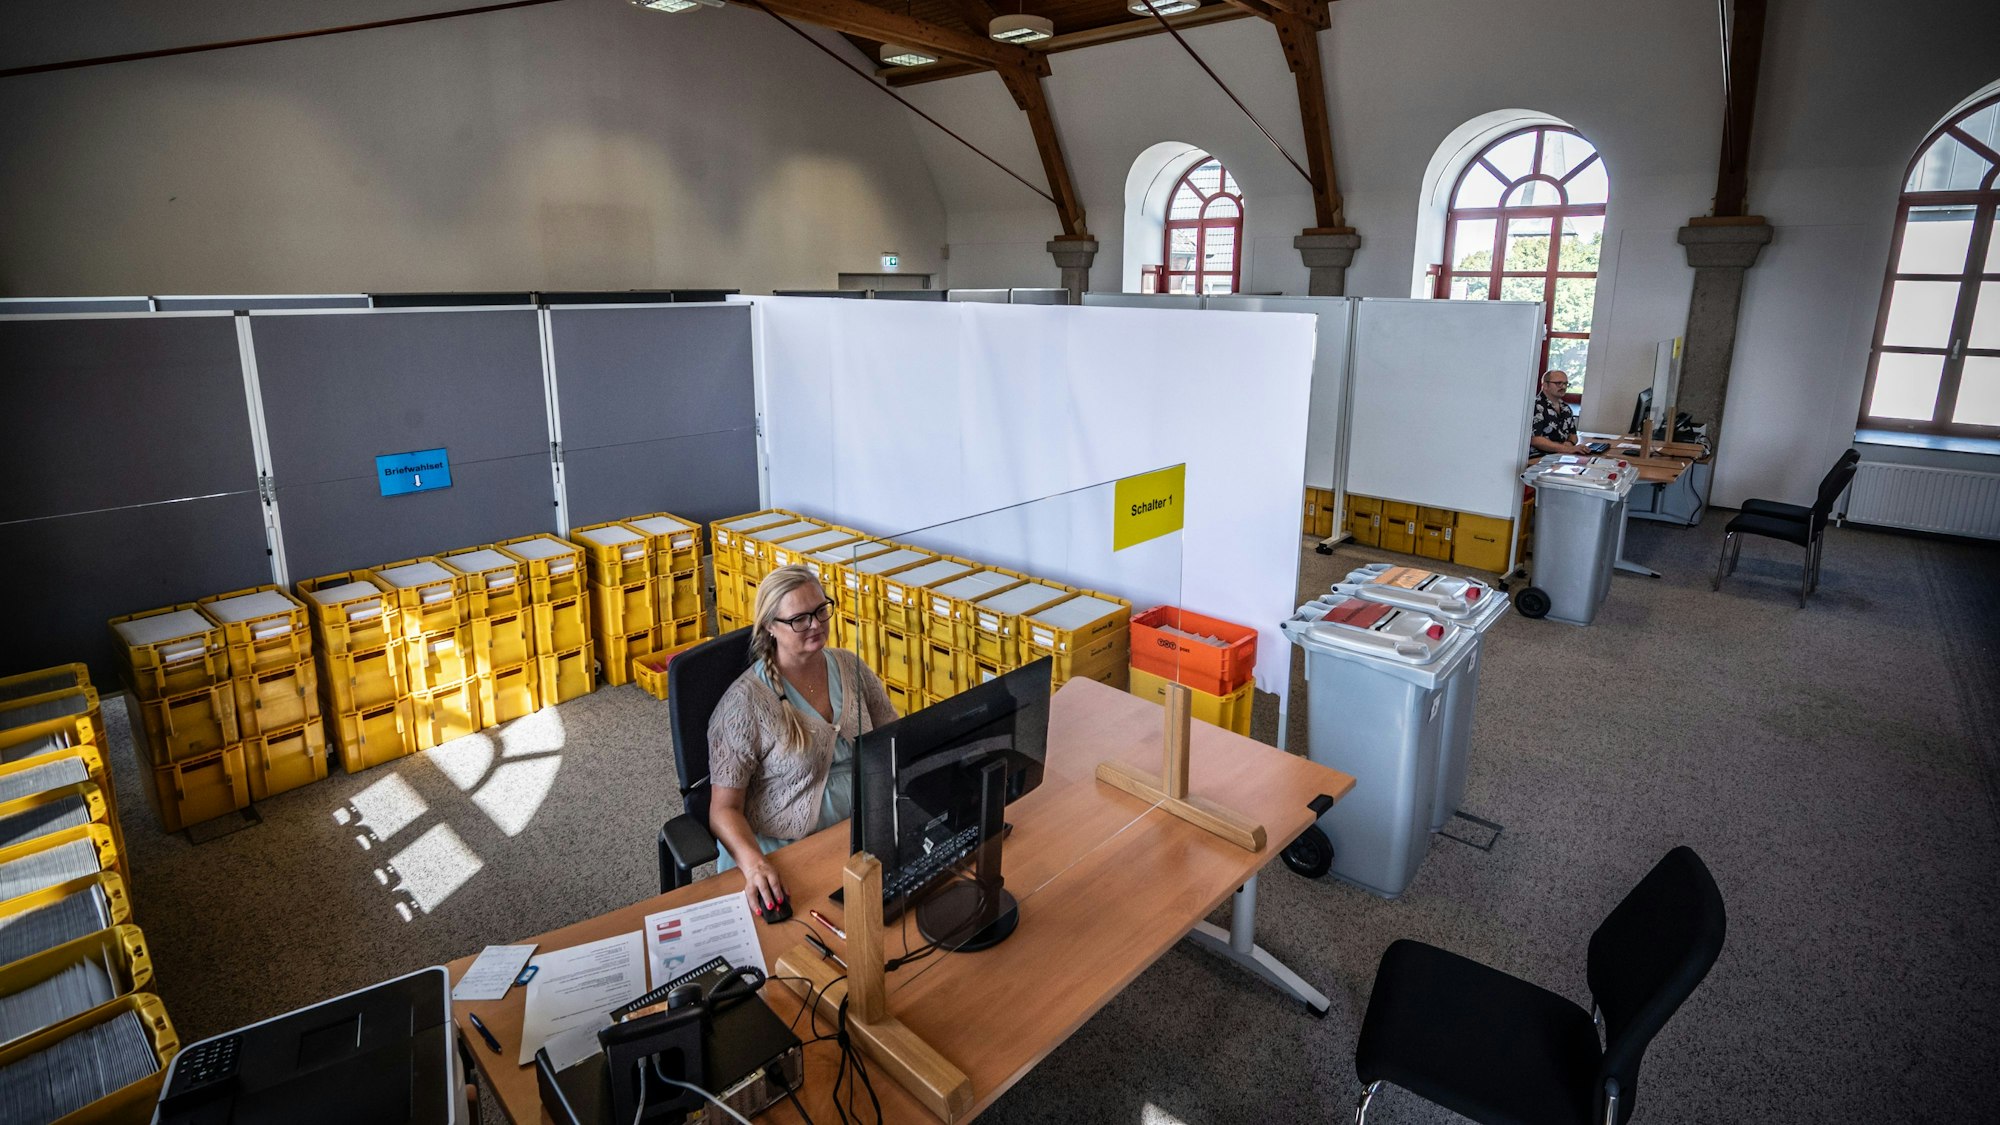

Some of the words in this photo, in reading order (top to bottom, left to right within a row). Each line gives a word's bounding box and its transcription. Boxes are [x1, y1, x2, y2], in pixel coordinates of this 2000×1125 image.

[384, 462, 443, 476] Briefwahlset
[1131, 498, 1166, 516] Schalter
[1169, 494, 1173, 505] 1
